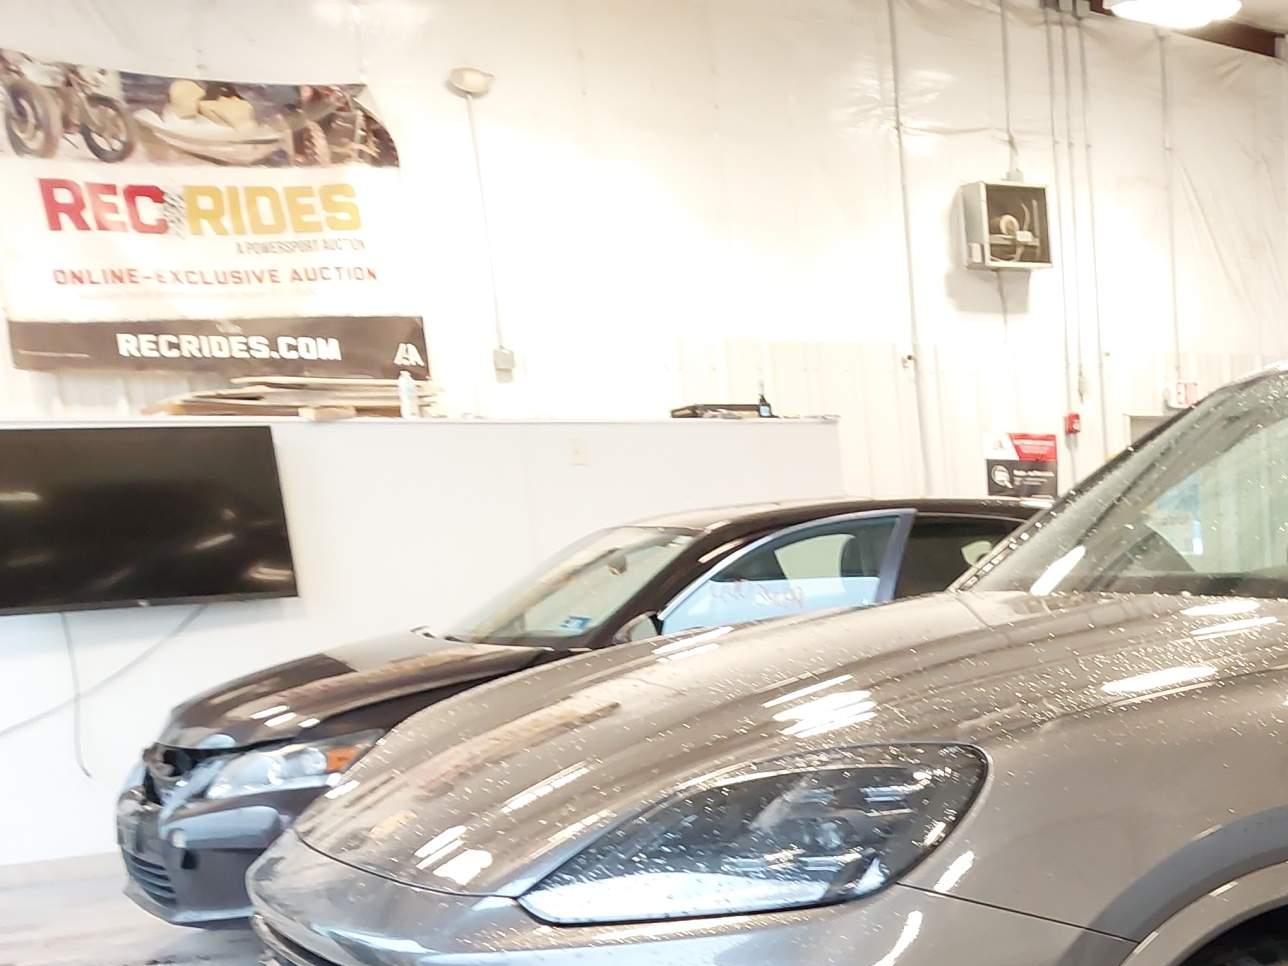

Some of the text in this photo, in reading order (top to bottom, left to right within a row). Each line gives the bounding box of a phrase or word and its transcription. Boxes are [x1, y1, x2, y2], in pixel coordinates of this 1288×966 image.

[38, 178, 362, 236] REC RIDES
[53, 265, 378, 286] ONLINE-EXCLUSIVE AUCTION
[115, 332, 342, 361] RECRIDES.COM
